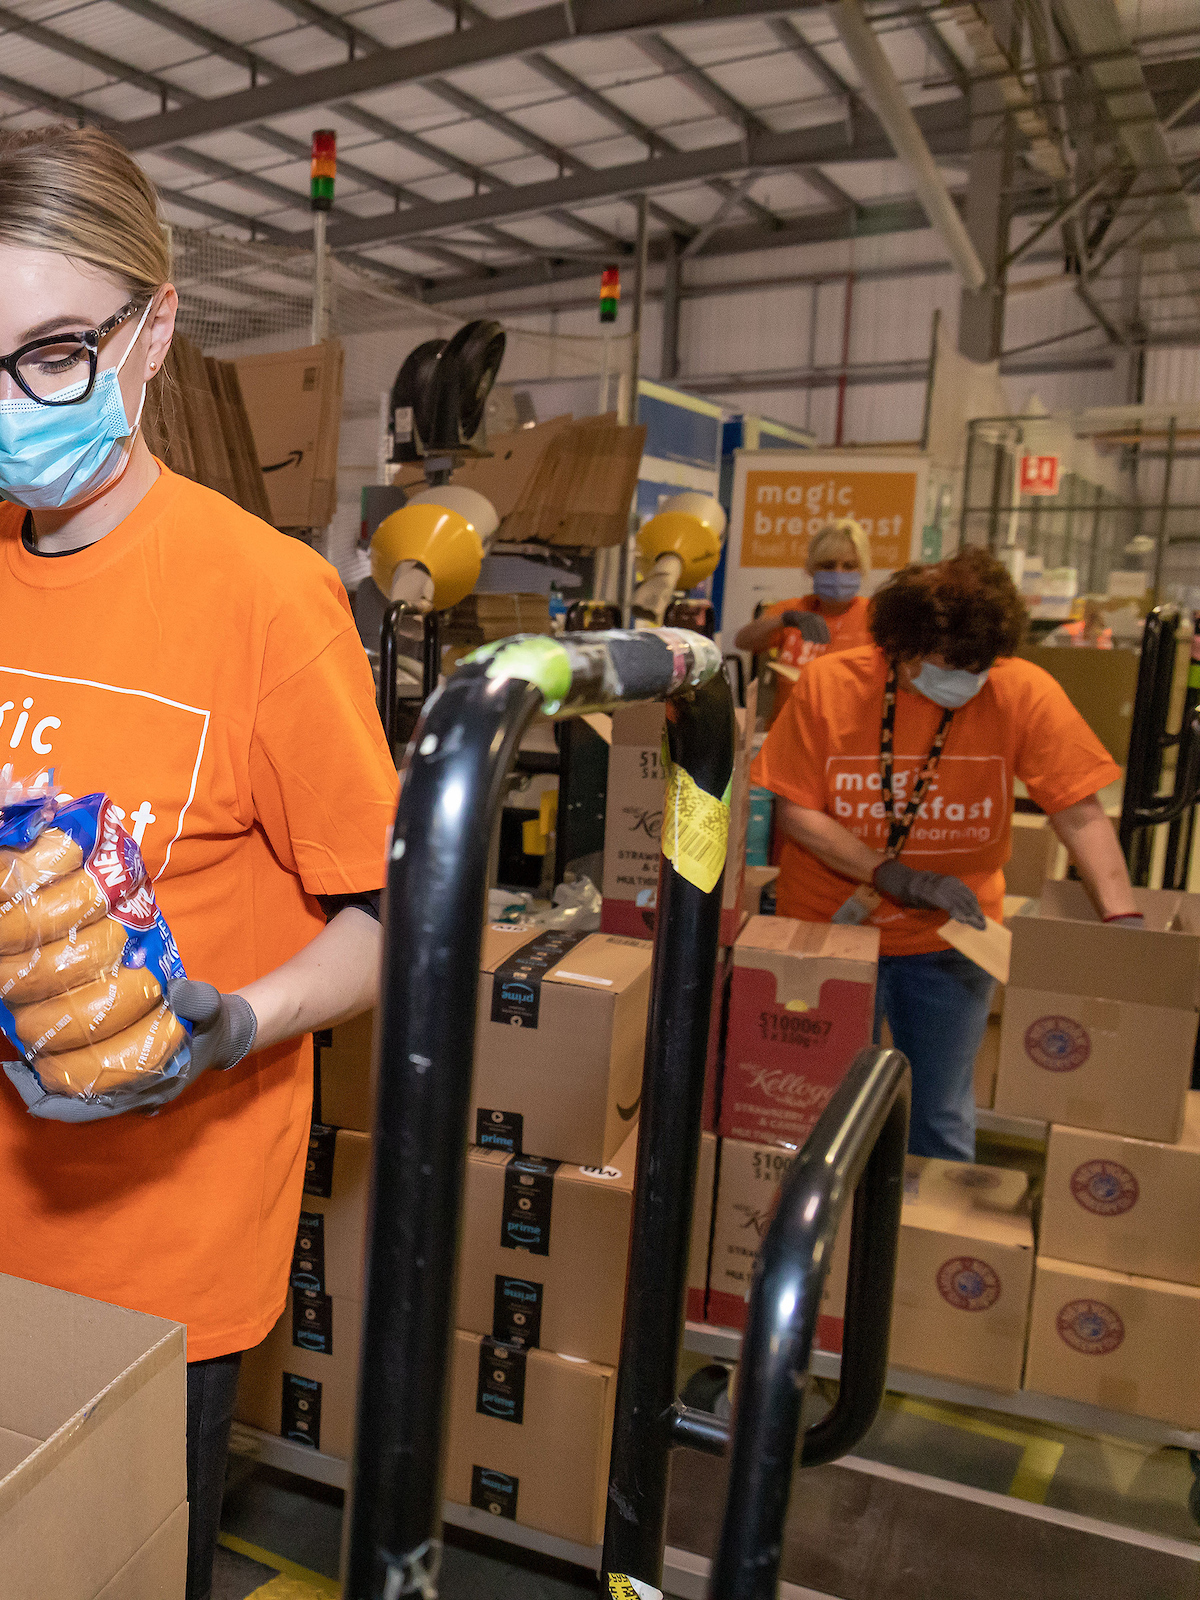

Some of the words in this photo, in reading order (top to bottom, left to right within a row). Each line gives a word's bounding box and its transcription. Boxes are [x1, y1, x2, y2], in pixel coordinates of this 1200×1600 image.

[756, 480, 852, 514] magic
[754, 510, 902, 536] breaast
[92, 1011, 106, 1025] FOR
[138, 1034, 154, 1066] FRESHER
[149, 1020, 160, 1034] FOR
[480, 1134, 514, 1148] prime
[507, 1221, 542, 1236] prime
